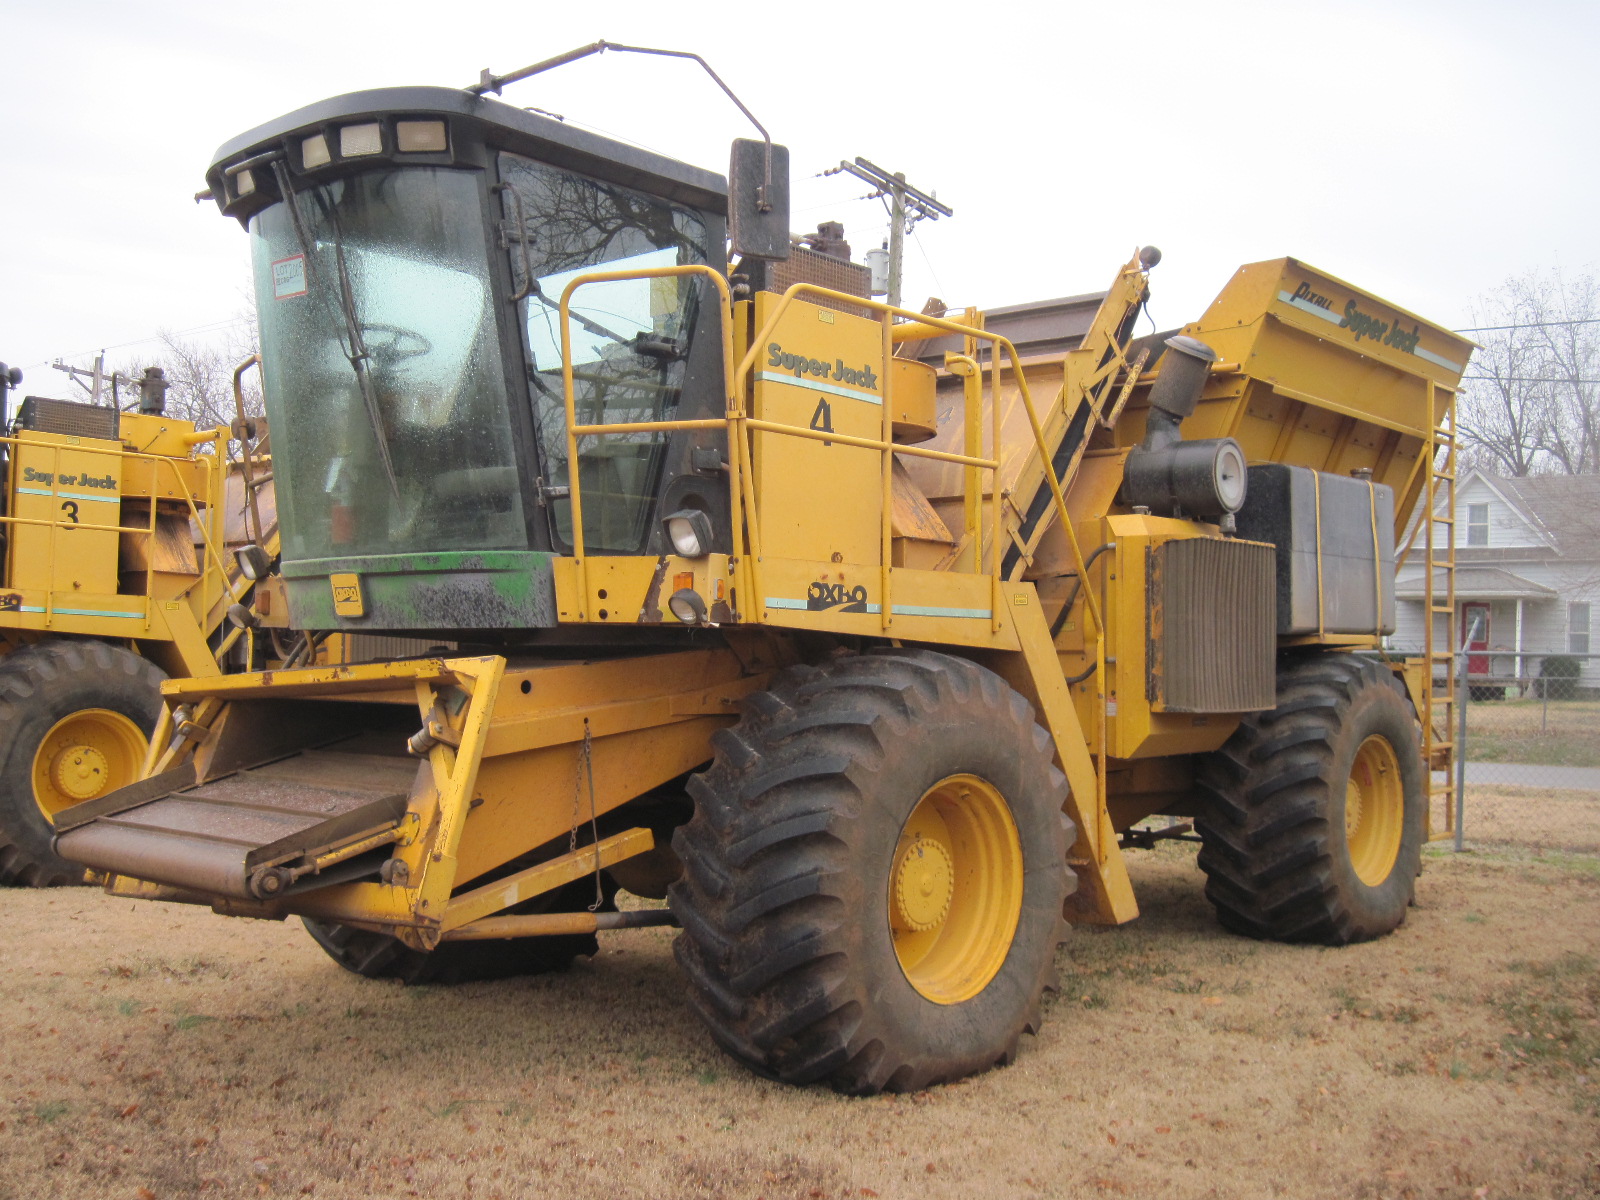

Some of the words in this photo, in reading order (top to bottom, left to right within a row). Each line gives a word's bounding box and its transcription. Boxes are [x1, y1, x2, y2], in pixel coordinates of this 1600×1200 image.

[1339, 299, 1388, 342] Super
[1384, 319, 1420, 355] Jack
[768, 342, 832, 378] Super
[832, 358, 878, 390] Jack
[810, 397, 834, 446] 4
[77, 473, 117, 490] Jack
[61, 501, 79, 530] 3
